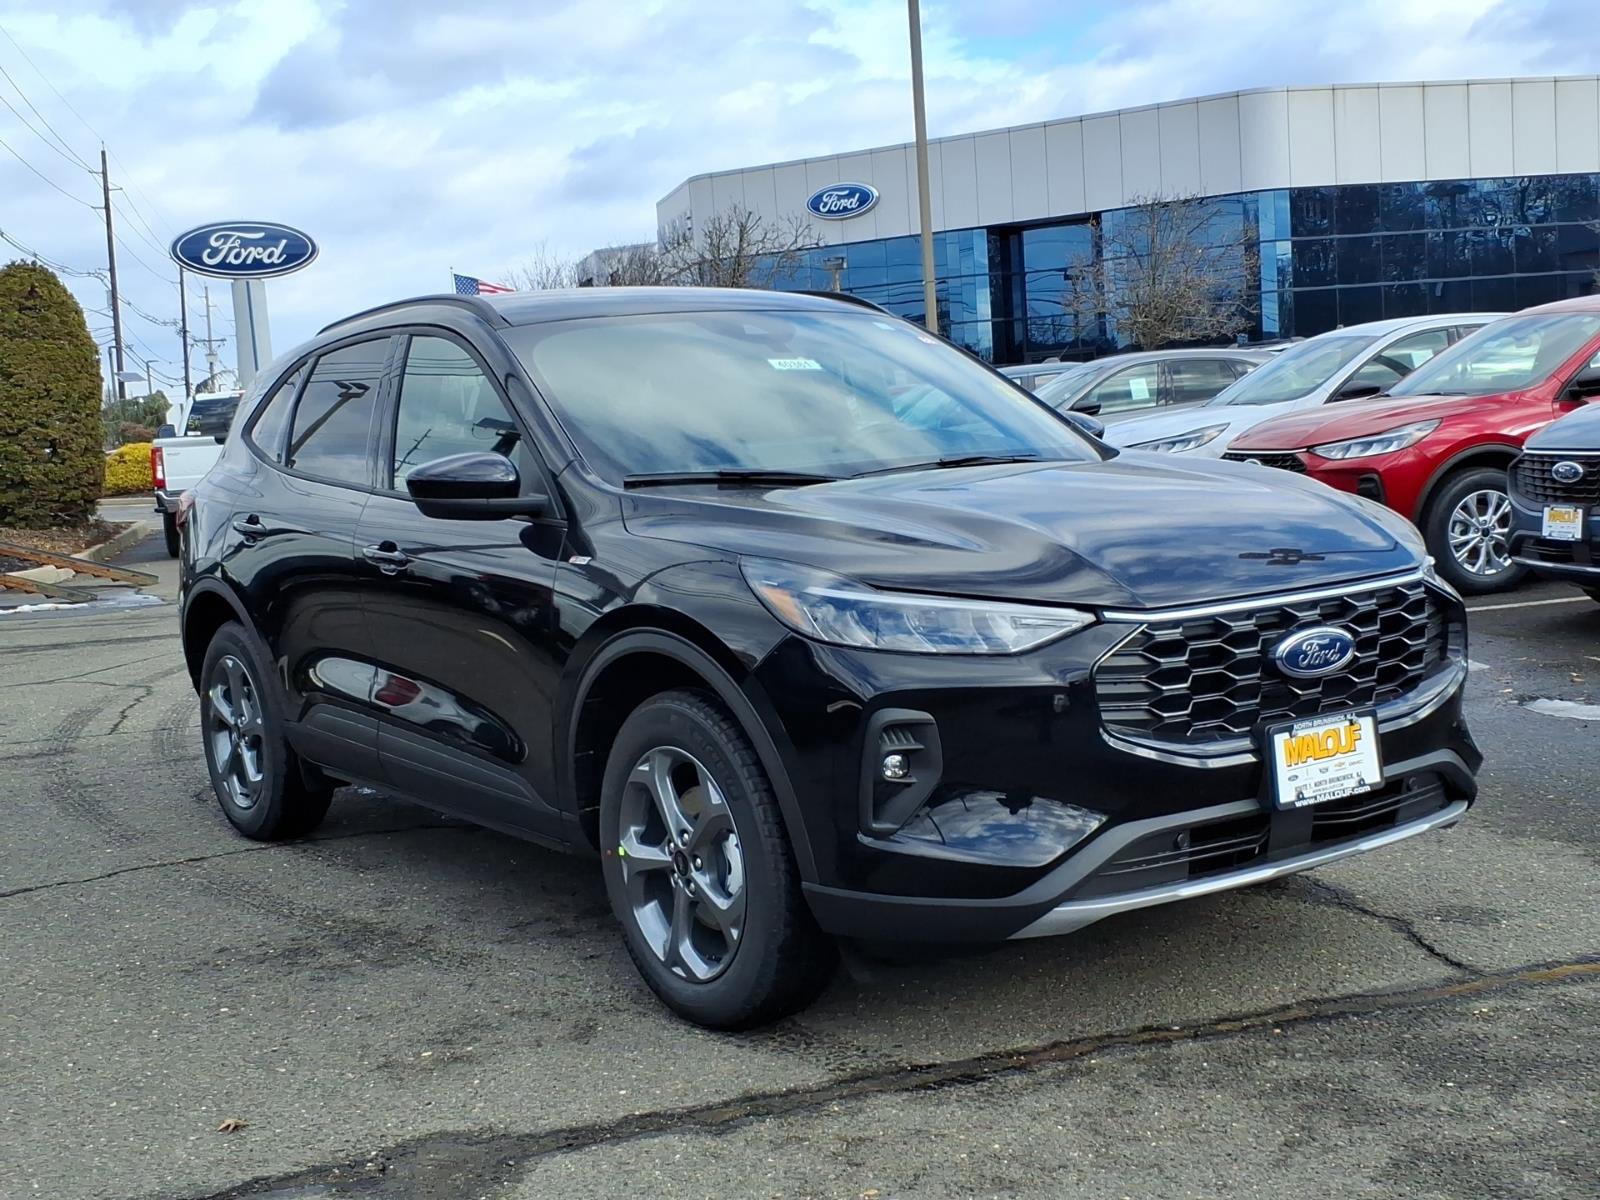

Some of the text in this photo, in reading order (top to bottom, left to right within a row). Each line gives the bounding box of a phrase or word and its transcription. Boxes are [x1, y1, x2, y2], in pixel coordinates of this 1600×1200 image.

[820, 190, 860, 212] Ford
[202, 231, 288, 265] Ford
[1298, 638, 1341, 667] Ford
[1284, 723, 1362, 767] MALOUF
[1295, 785, 1371, 807] www.MALOUF.com
